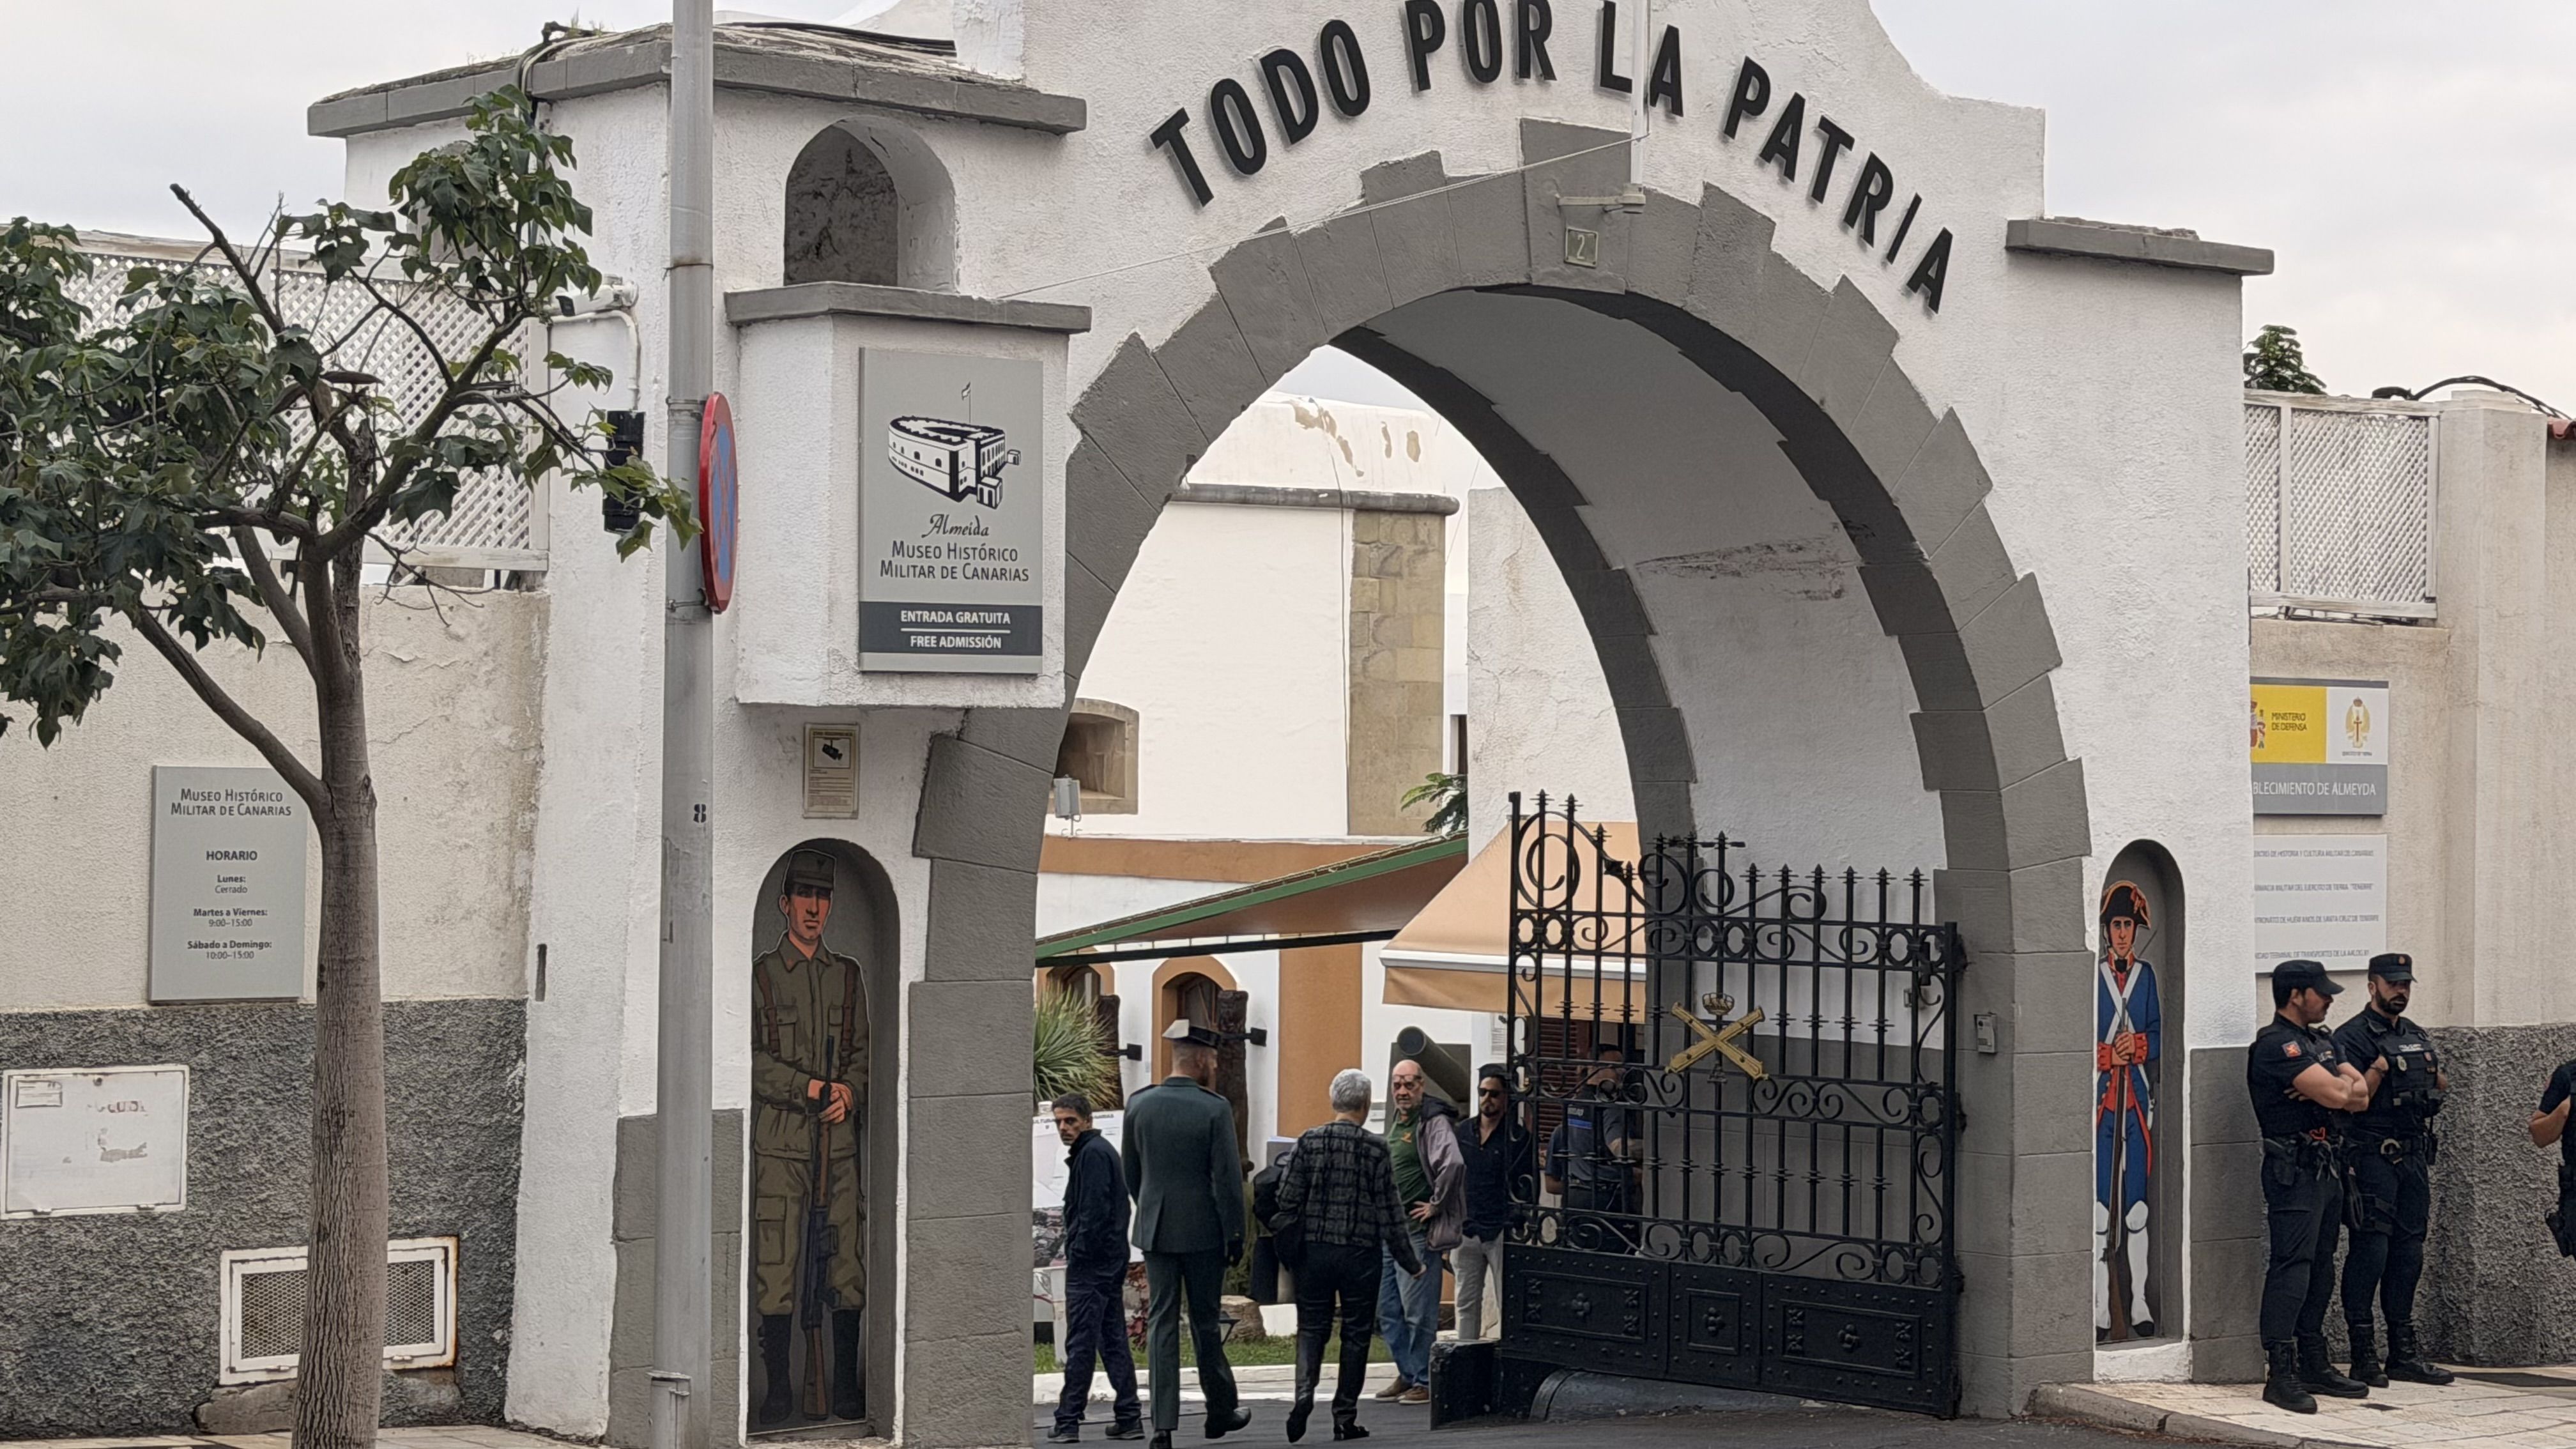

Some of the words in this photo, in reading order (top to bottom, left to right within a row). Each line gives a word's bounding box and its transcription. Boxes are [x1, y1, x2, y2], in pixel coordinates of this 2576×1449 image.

[1149, 18, 1371, 208] TODO
[1404, 0, 1558, 91] POR
[1599, 0, 1684, 118] LA
[1723, 55, 1954, 314] PATRIA
[1576, 233, 1585, 260] 2
[921, 513, 990, 539] Almeida
[880, 559, 936, 579] MILITAR
[940, 565, 958, 580] DE
[962, 562, 1029, 582] CANARIAS
[900, 610, 954, 624] ENTRADA
[956, 611, 1011, 625] GRATUITA
[910, 635, 937, 648] FREE
[939, 635, 1002, 649] ADMISSIÓN
[2271, 712, 2306, 721] MINISTERIO
[2271, 722, 2280, 731] DE
[2280, 722, 2308, 732] DEFENSA
[2253, 781, 2315, 795] BLECIMIENTO
[2317, 782, 2329, 795] DE
[2331, 782, 2376, 796] ALMEYDA
[171, 802, 216, 816] MILITAR
[220, 806, 234, 816] DE
[237, 803, 291, 816] CANARIAS
[206, 850, 258, 861] HORARIO
[217, 875, 246, 884] Lunes:
[215, 885, 247, 894] Cerrado
[193, 908, 224, 917] Martes
[233, 908, 268, 916] Viernes:
[187, 940, 220, 949] Sábado
[229, 940, 272, 950] Domingo:
